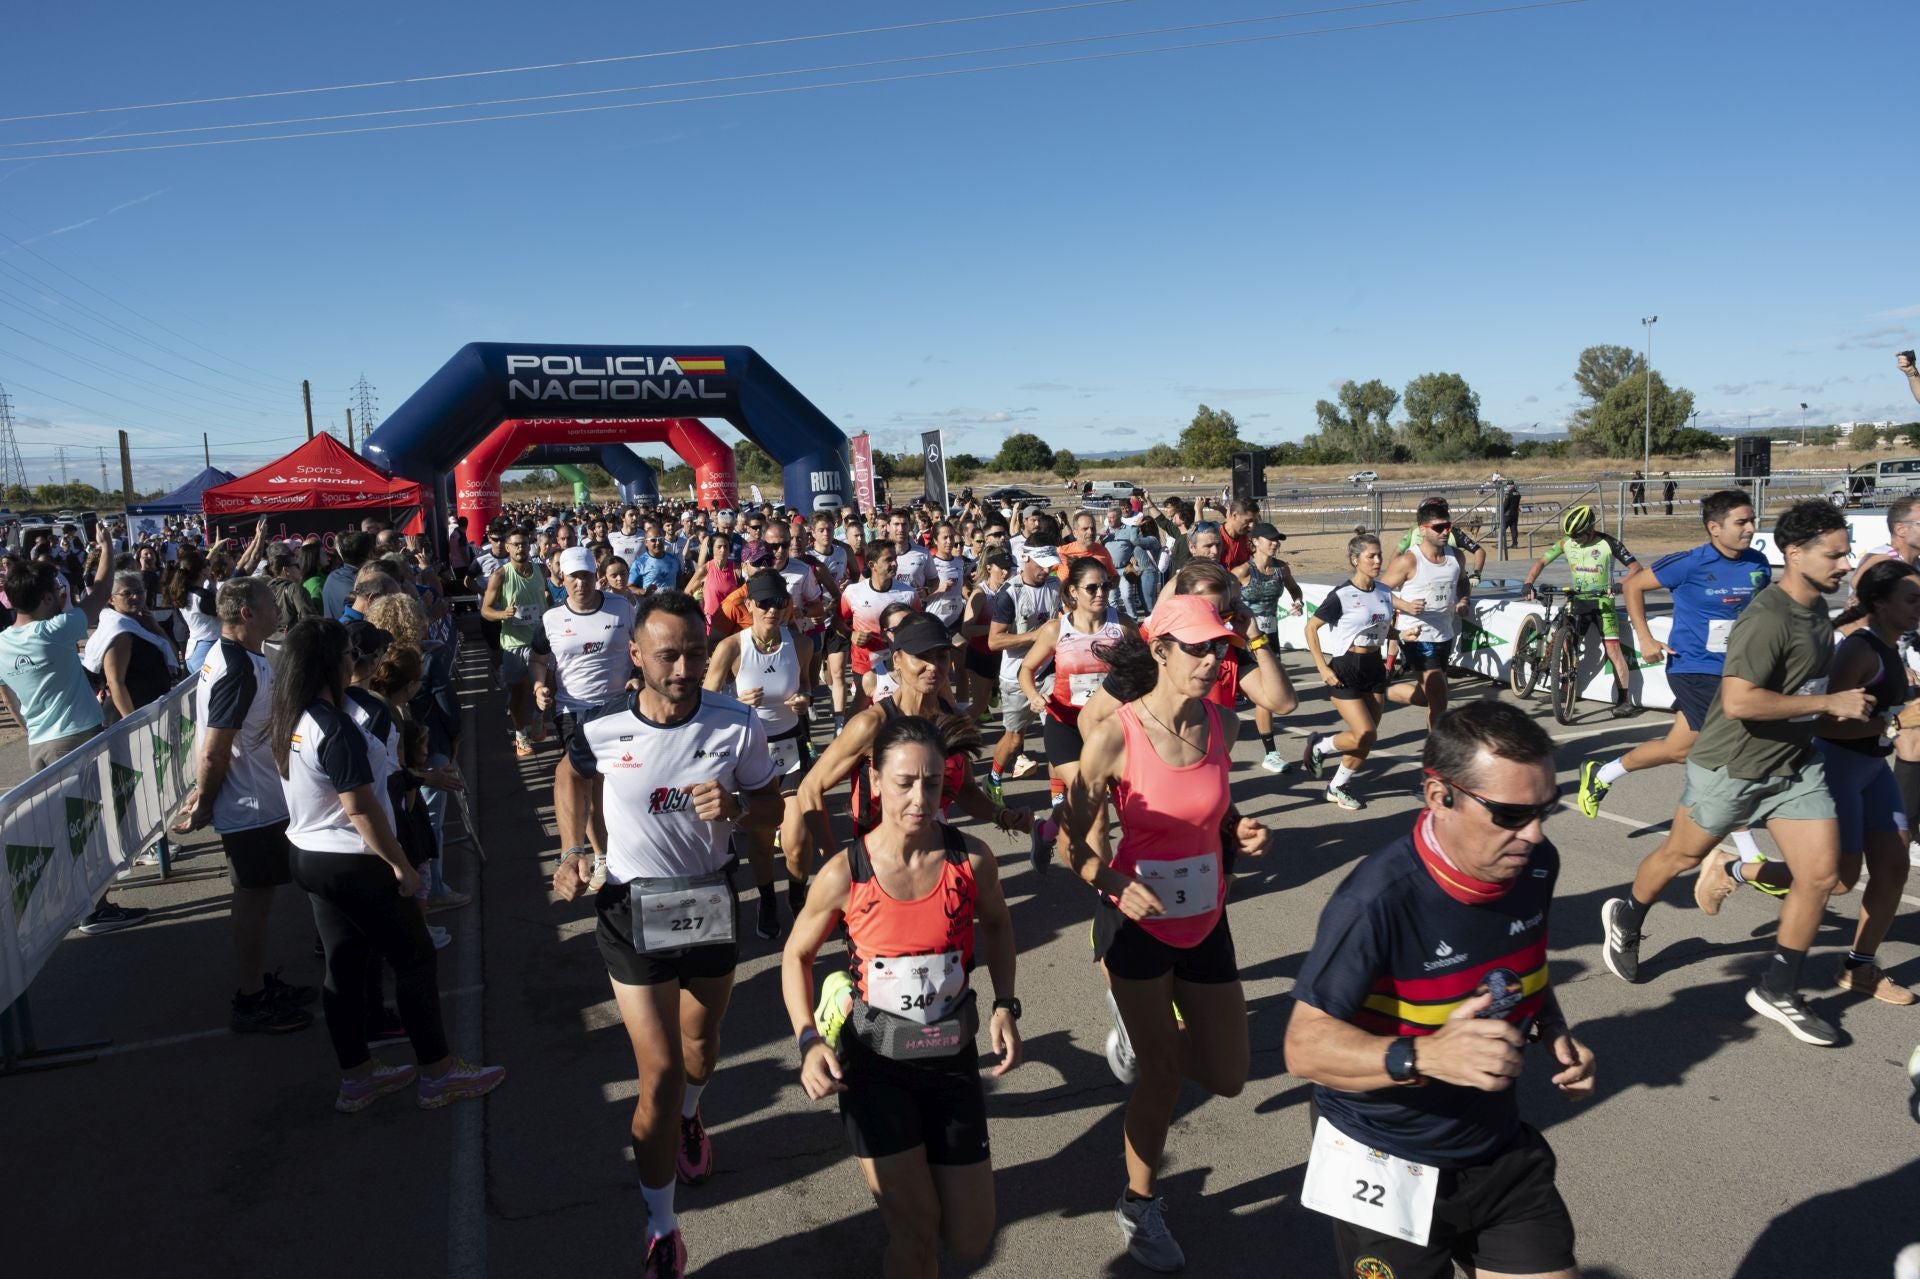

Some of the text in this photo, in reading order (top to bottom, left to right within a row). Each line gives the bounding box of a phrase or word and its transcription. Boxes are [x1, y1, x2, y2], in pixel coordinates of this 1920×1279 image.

[508, 378, 727, 400] NACIONAL
[296, 465, 343, 475] Sports
[289, 476, 366, 485] Santander
[810, 470, 842, 492] RUTA
[215, 494, 308, 508] Sports Santander
[321, 492, 350, 503] Sports
[613, 761, 644, 769] Santander
[1175, 890, 1186, 905] 3
[671, 917, 704, 932] 227
[1352, 1179, 1386, 1208] 22
